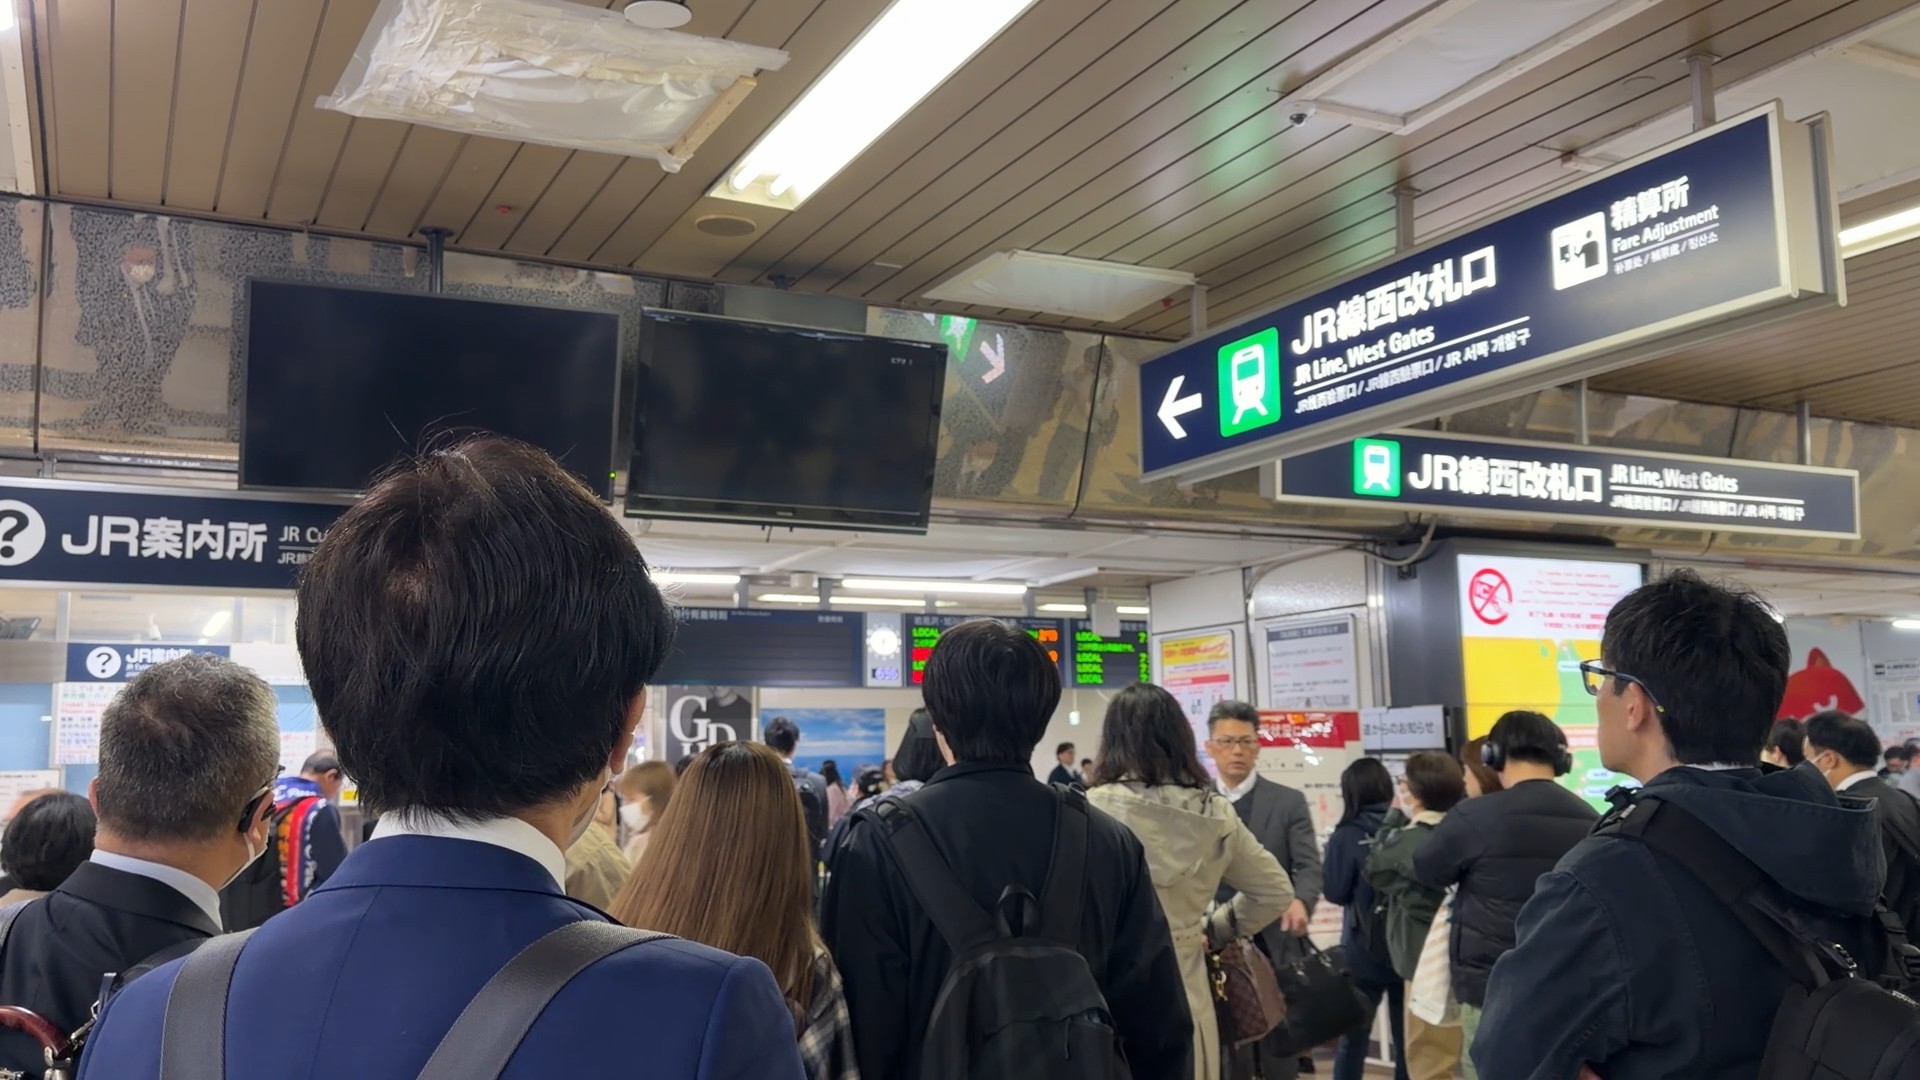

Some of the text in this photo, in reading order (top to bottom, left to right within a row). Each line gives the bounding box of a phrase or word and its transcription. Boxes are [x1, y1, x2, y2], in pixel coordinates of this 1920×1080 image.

[1610, 175, 1689, 231] 精算所
[1612, 204, 1719, 254] Fare Adjustment
[1291, 245, 1497, 355] JR線西改札口
[1293, 364, 1312, 387] JR
[1389, 325, 1435, 352] Gates
[1443, 352, 1462, 369] JR
[1408, 453, 1602, 503] JR線西改札口
[1610, 463, 1628, 484] JR
[1700, 471, 1738, 494] Gates
[61, 514, 267, 563] JR案内所
[278, 525, 329, 543] JR Cu
[1075, 652, 1104, 663] LOCAL
[1076, 663, 1104, 673] LOCAL
[1076, 673, 1105, 684] LOCAL
